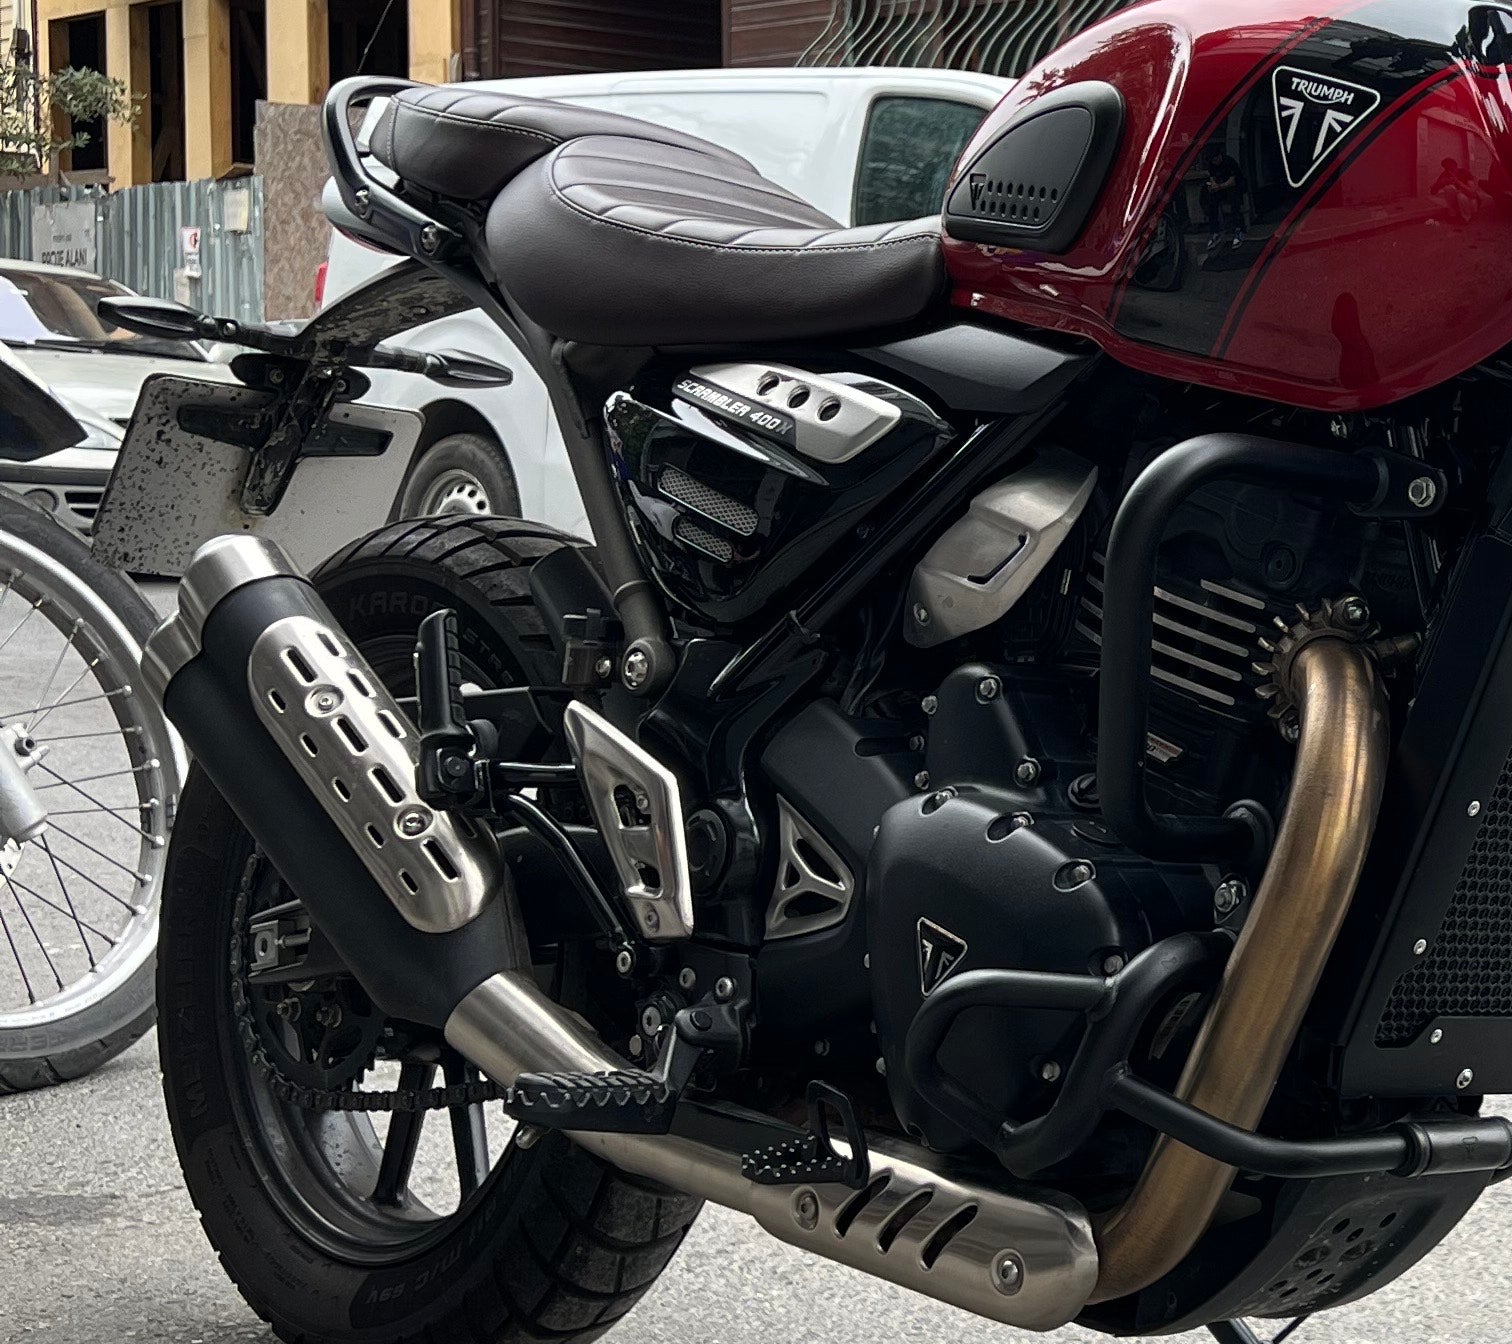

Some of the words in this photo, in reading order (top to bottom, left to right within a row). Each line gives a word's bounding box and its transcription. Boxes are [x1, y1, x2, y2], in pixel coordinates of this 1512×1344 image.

[1291, 76, 1355, 105] TRIUMPH
[677, 379, 751, 417] SCRAMBLER
[351, 590, 447, 620] KARO
[462, 627, 514, 686] STRE
